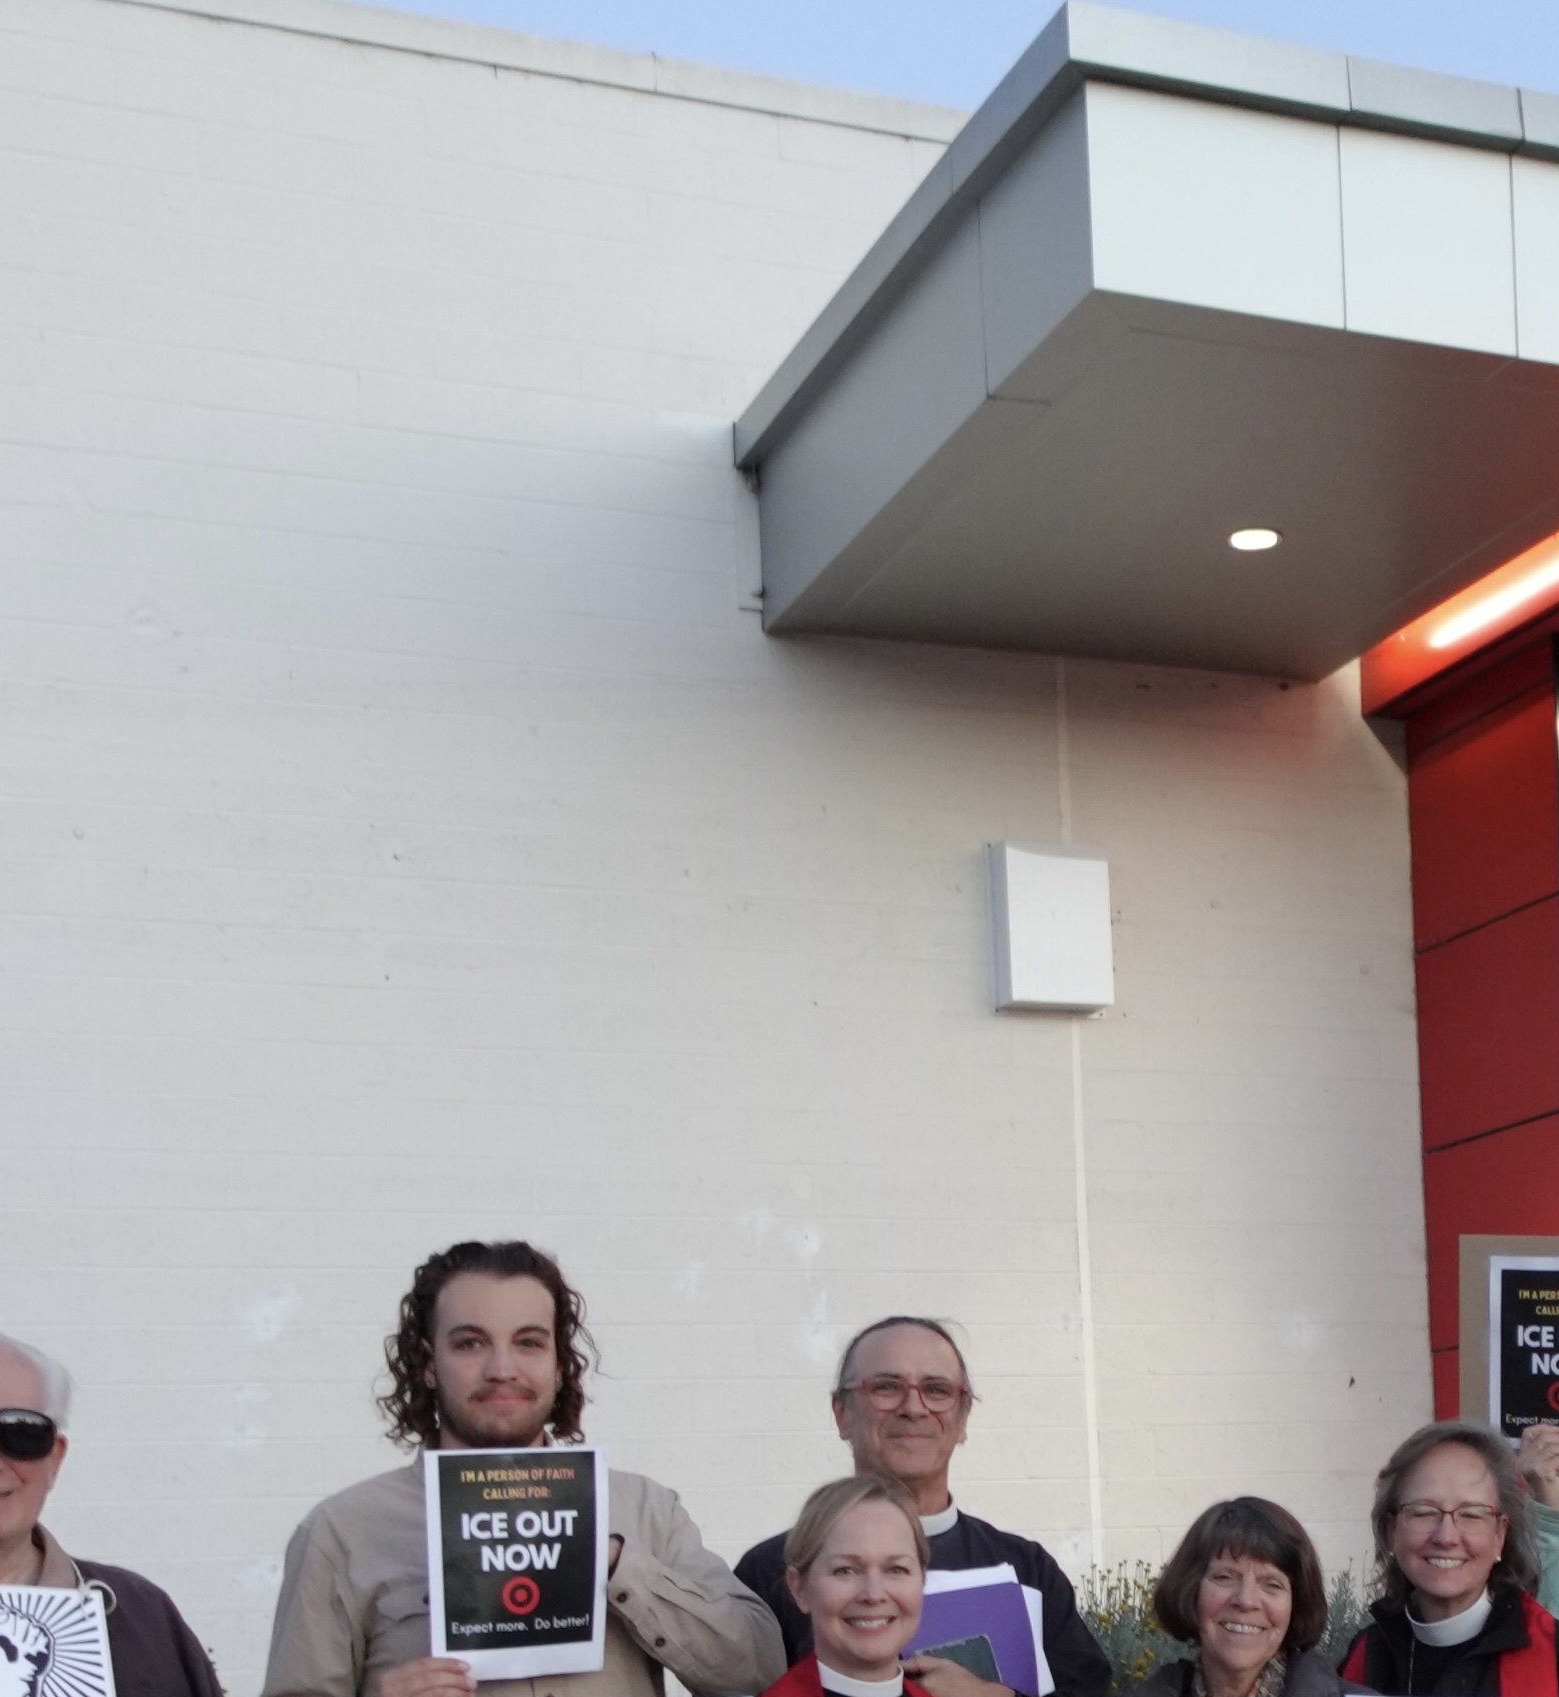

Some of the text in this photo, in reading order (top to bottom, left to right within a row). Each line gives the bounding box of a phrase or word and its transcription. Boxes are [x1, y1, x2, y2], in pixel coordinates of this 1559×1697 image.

[1531, 1290, 1538, 1299] A
[1517, 1325, 1555, 1348] ICE
[1505, 1413, 1539, 1426] Expect
[477, 1471, 486, 1482] A
[486, 1470, 529, 1481] PERSON
[531, 1469, 543, 1480] OF
[546, 1468, 574, 1480] FAITH
[483, 1488, 526, 1500] CALLING
[461, 1510, 578, 1540] ICE OUT
[481, 1543, 562, 1572] NOW
[451, 1622, 493, 1636] Expect
[534, 1617, 551, 1629] Do
[553, 1614, 589, 1629] better!
